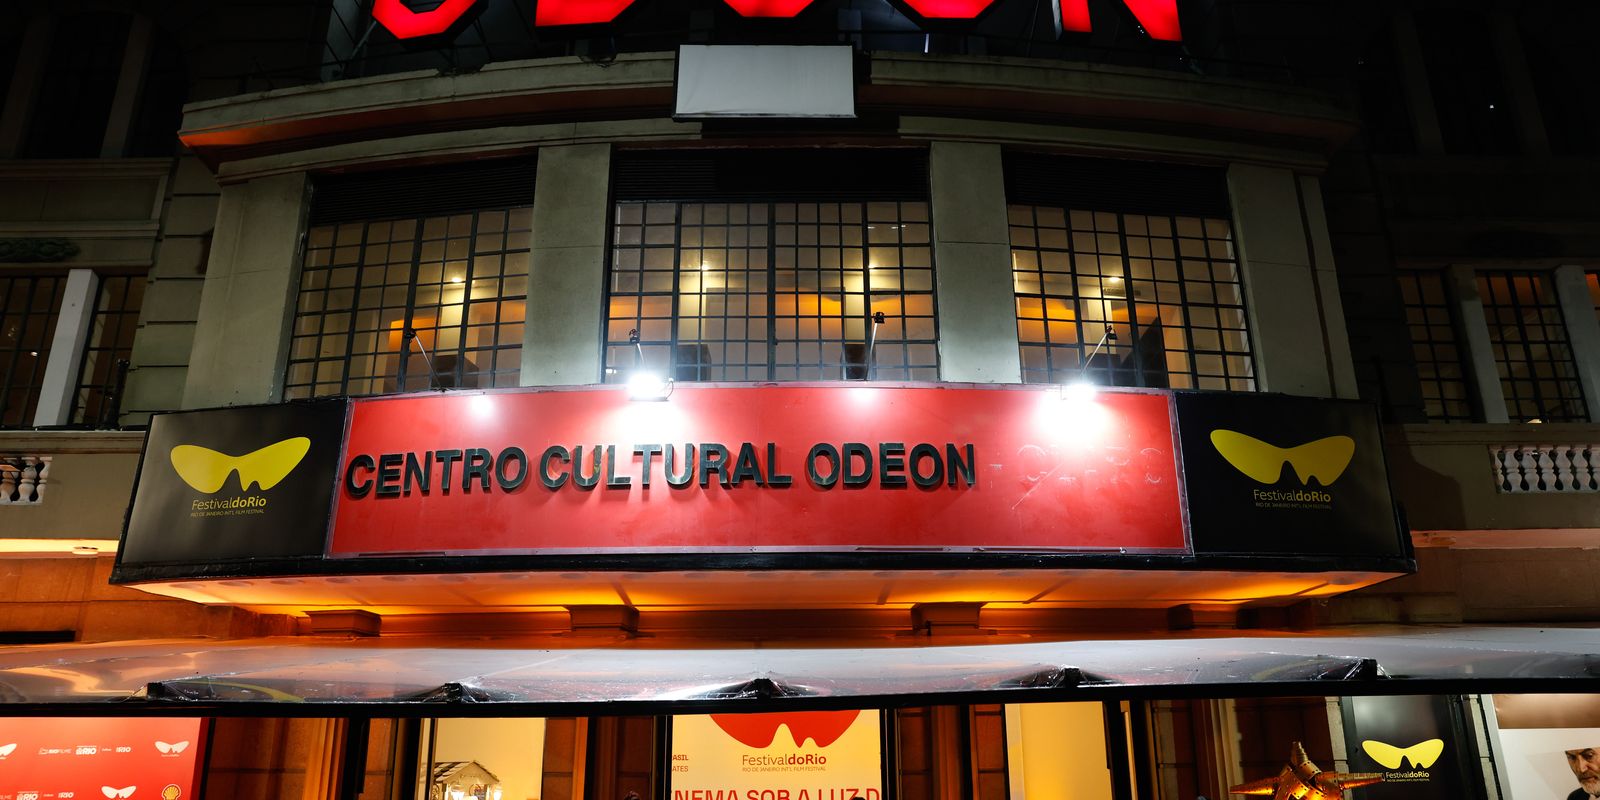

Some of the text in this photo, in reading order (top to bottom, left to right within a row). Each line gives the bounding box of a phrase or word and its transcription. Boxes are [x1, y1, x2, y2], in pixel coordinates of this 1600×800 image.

[345, 442, 976, 499] CENTRO CULTURAL ODEON
[191, 495, 267, 511] FestivaldoRio
[1253, 489, 1332, 503] FestivaldoRio
[742, 753, 827, 766] FestivaldoRio
[1385, 771, 1430, 779] FestivaldoRio
